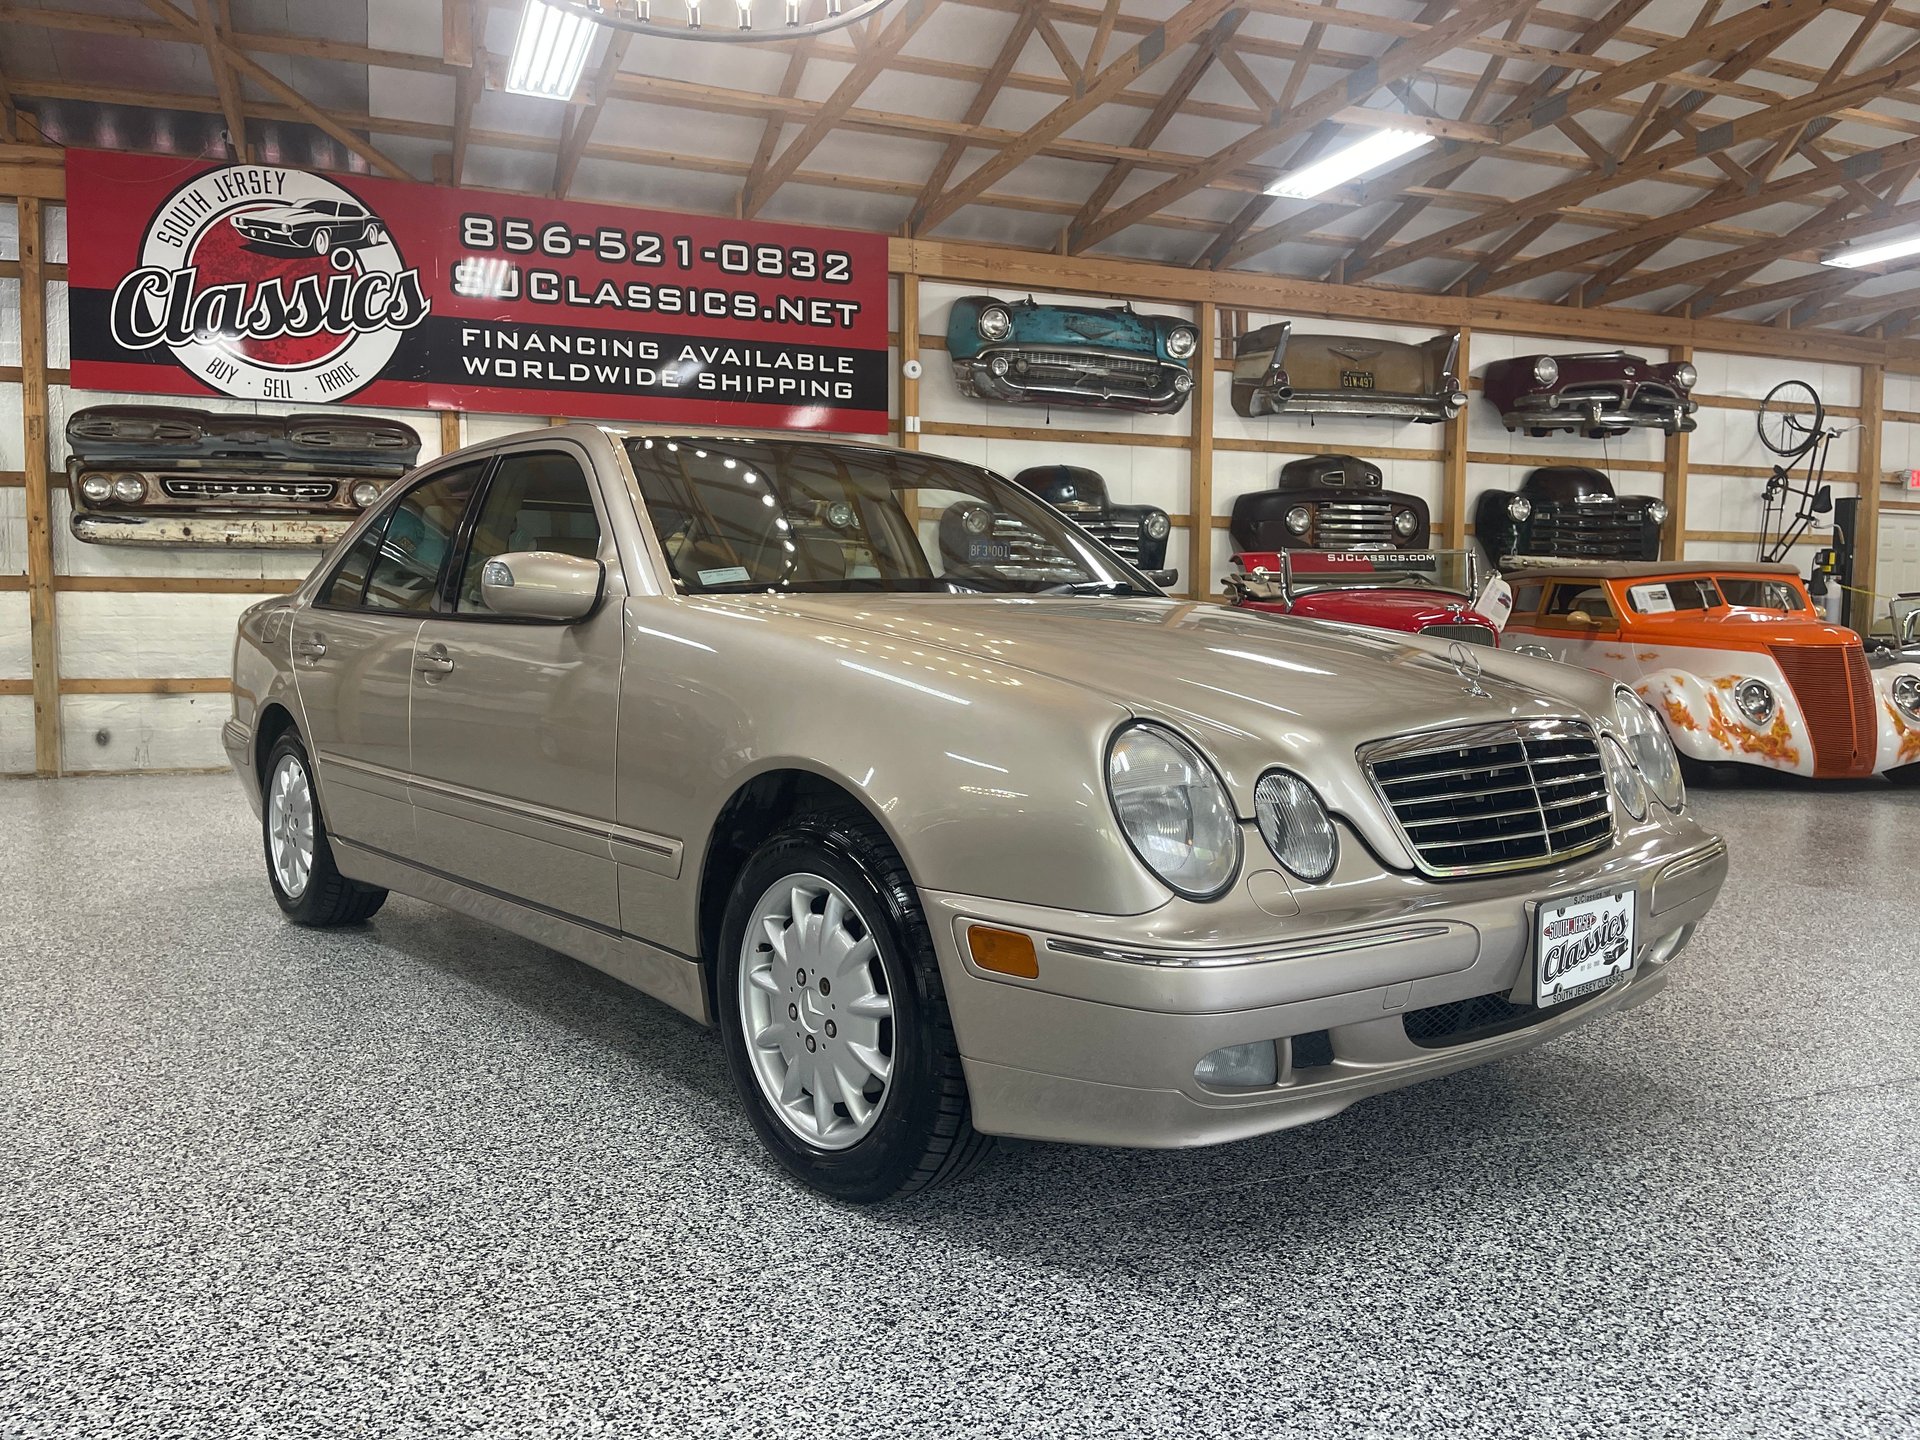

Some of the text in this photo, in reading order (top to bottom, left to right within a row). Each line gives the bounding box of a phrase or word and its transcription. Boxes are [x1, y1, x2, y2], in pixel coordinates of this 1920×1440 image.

[157, 169, 287, 248] SOUTH JERSEY
[461, 214, 851, 283] 856-521-0832
[110, 248, 432, 350] Classics
[462, 328, 854, 374] FINANCING AVAILABLE
[205, 356, 360, 399] BUY SELL TRADE
[462, 355, 853, 399] WORLDWIDE SHIPPING
[1327, 553, 1435, 562] SJCLASSICS.COM
[1541, 908, 1629, 985] Classics
[1549, 912, 1594, 940] SOUTH JERSEY
[1553, 972, 1625, 1003] SOUTH JERSEY CLASSICS
